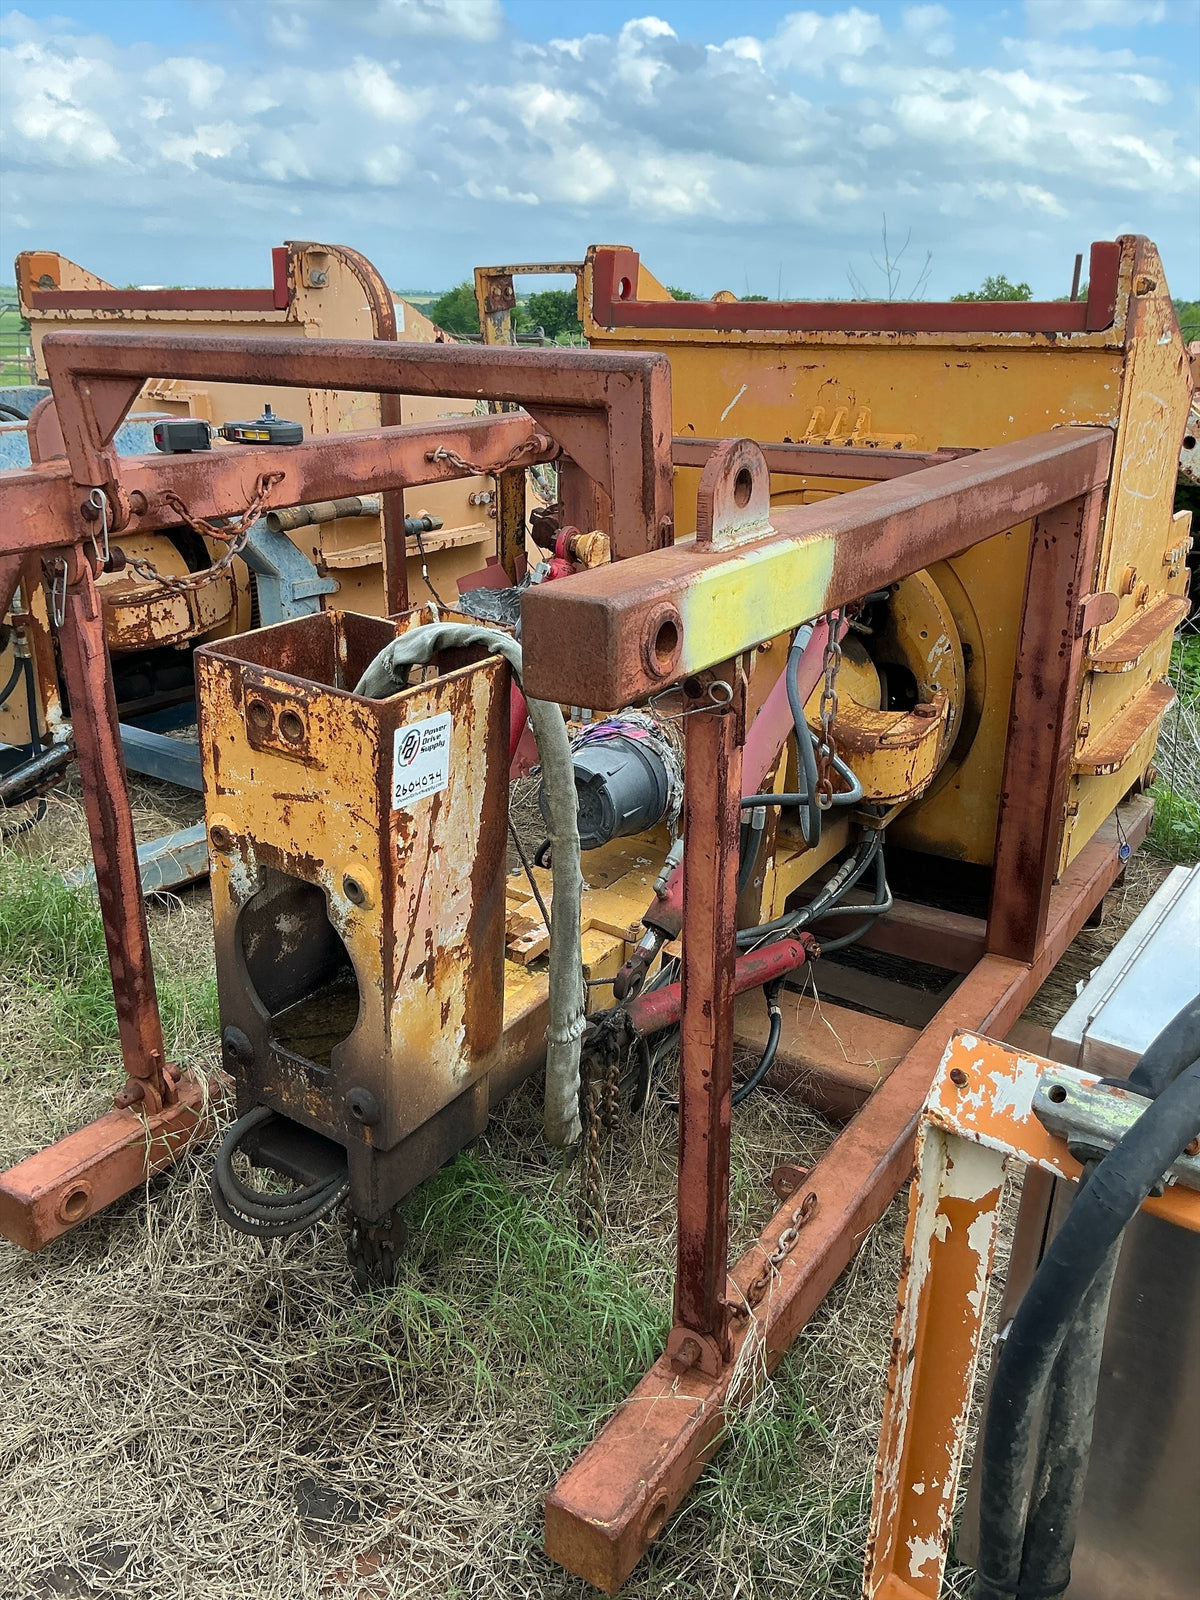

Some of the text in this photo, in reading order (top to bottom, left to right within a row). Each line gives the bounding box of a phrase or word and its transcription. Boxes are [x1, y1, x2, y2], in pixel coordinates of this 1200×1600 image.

[423, 724, 448, 737] Power
[421, 733, 442, 746] Drive
[420, 740, 446, 754] Supply
[395, 768, 442, 798] 2604074
